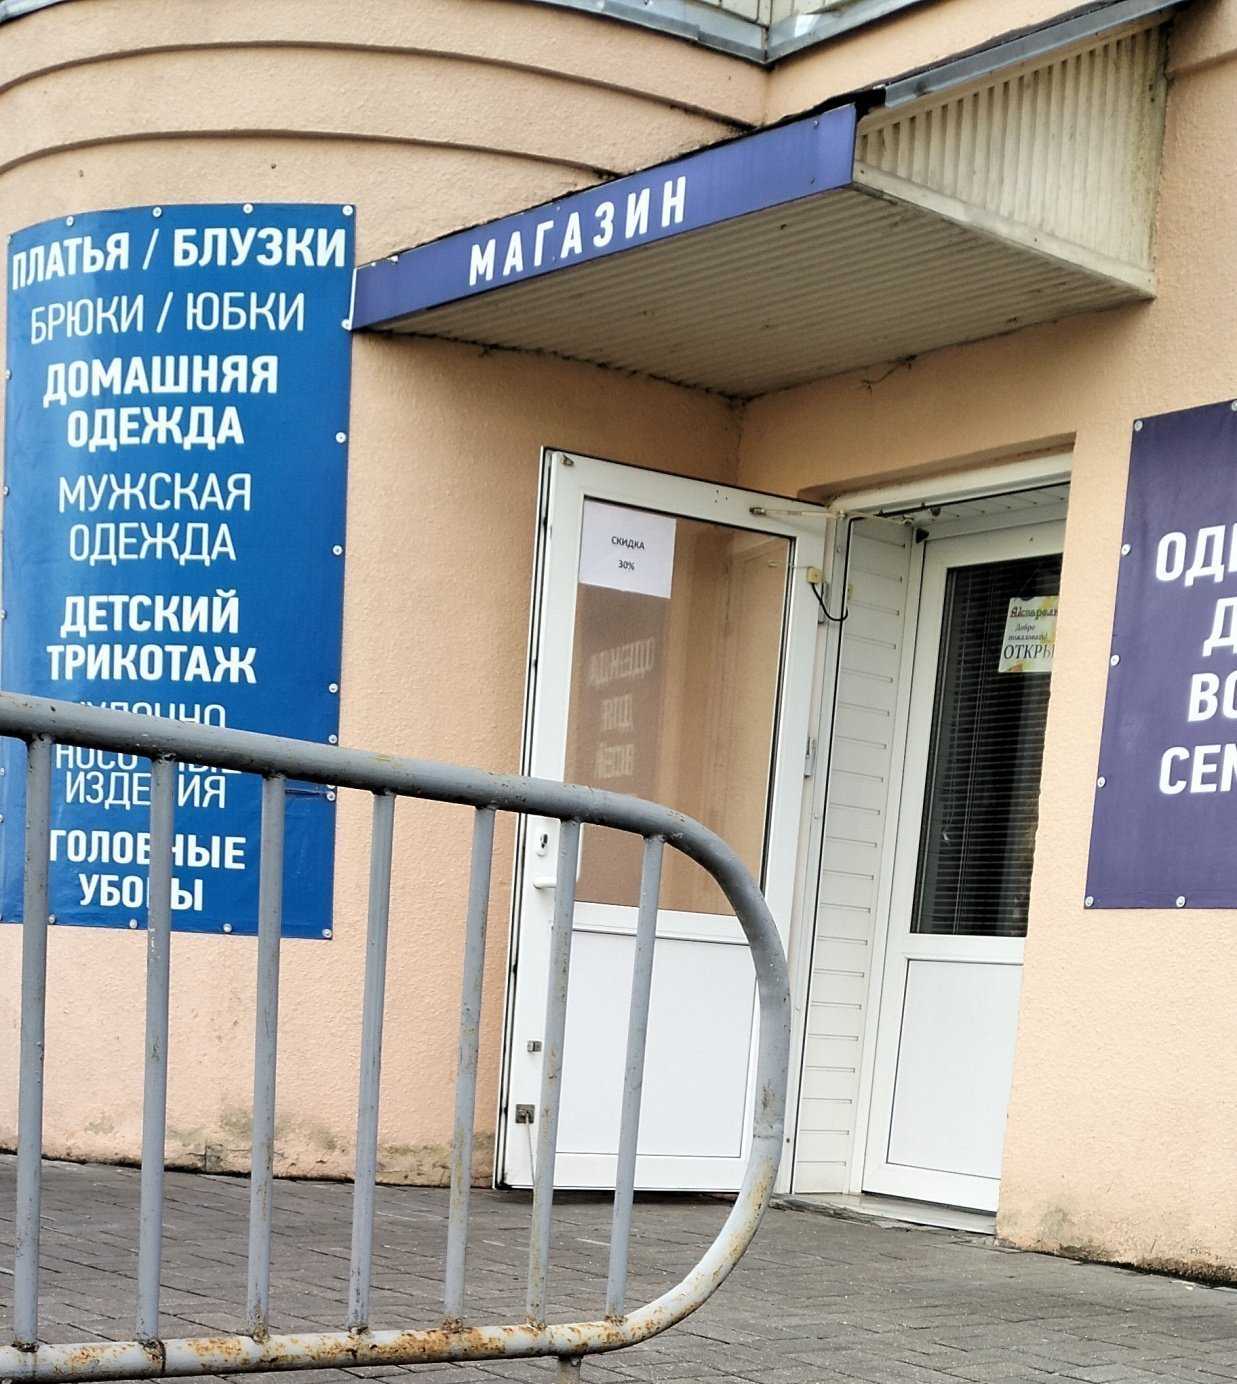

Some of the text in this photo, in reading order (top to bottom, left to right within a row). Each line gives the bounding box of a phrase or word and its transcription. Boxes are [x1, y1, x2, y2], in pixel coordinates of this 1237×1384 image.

[469, 176, 686, 286] МАГАЗИН
[12, 232, 129, 290] ПЛАТЬЯ
[173, 227, 346, 267] БЛУЗКИ
[31, 295, 144, 345] БРЮКИ
[187, 292, 304, 331] ЮБКИ
[43, 355, 278, 408] ДОМАШНЯЯ
[67, 406, 244, 453] ОДЕЖДА
[58, 473, 251, 513] МУЖСКАЯ
[69, 522, 236, 566] ОДЕЖДА
[611, 536, 645, 550] СКИДКА
[618, 560, 635, 570] 30%
[60, 589, 239, 637] ДЕТСКИЙ
[46, 645, 256, 684] ТРИКОТАЖ
[66, 771, 226, 810] ИЗДЕИЯ
[79, 873, 203, 911] УБОЫ
